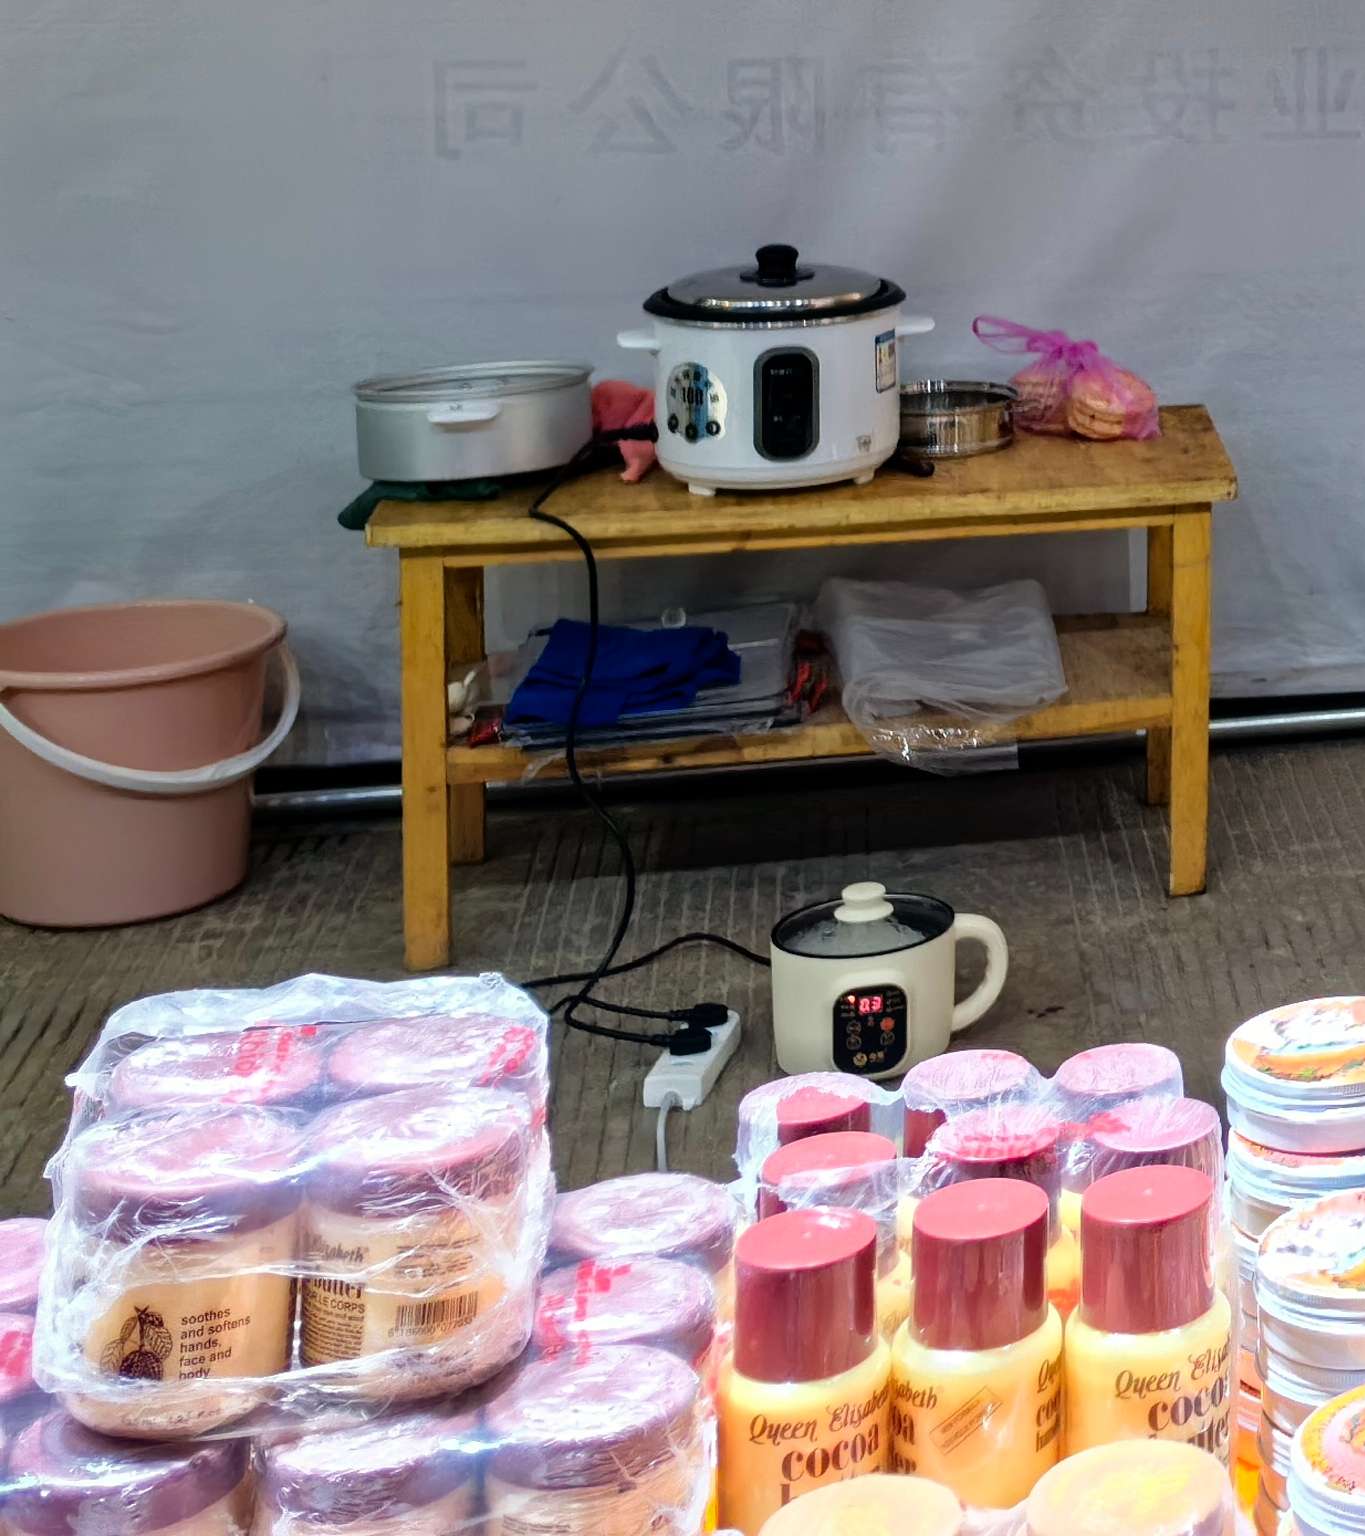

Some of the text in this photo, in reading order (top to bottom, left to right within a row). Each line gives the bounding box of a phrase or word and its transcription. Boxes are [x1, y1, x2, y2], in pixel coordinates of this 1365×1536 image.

[180, 1307, 231, 1326] soothes
[331, 1299, 366, 1314] CORPS
[180, 1314, 251, 1340] and softens
[178, 1347, 232, 1367] face and
[1115, 1369, 1182, 1400] Queen
[749, 1414, 819, 1446] Queen
[781, 1423, 880, 1482] cocoa
